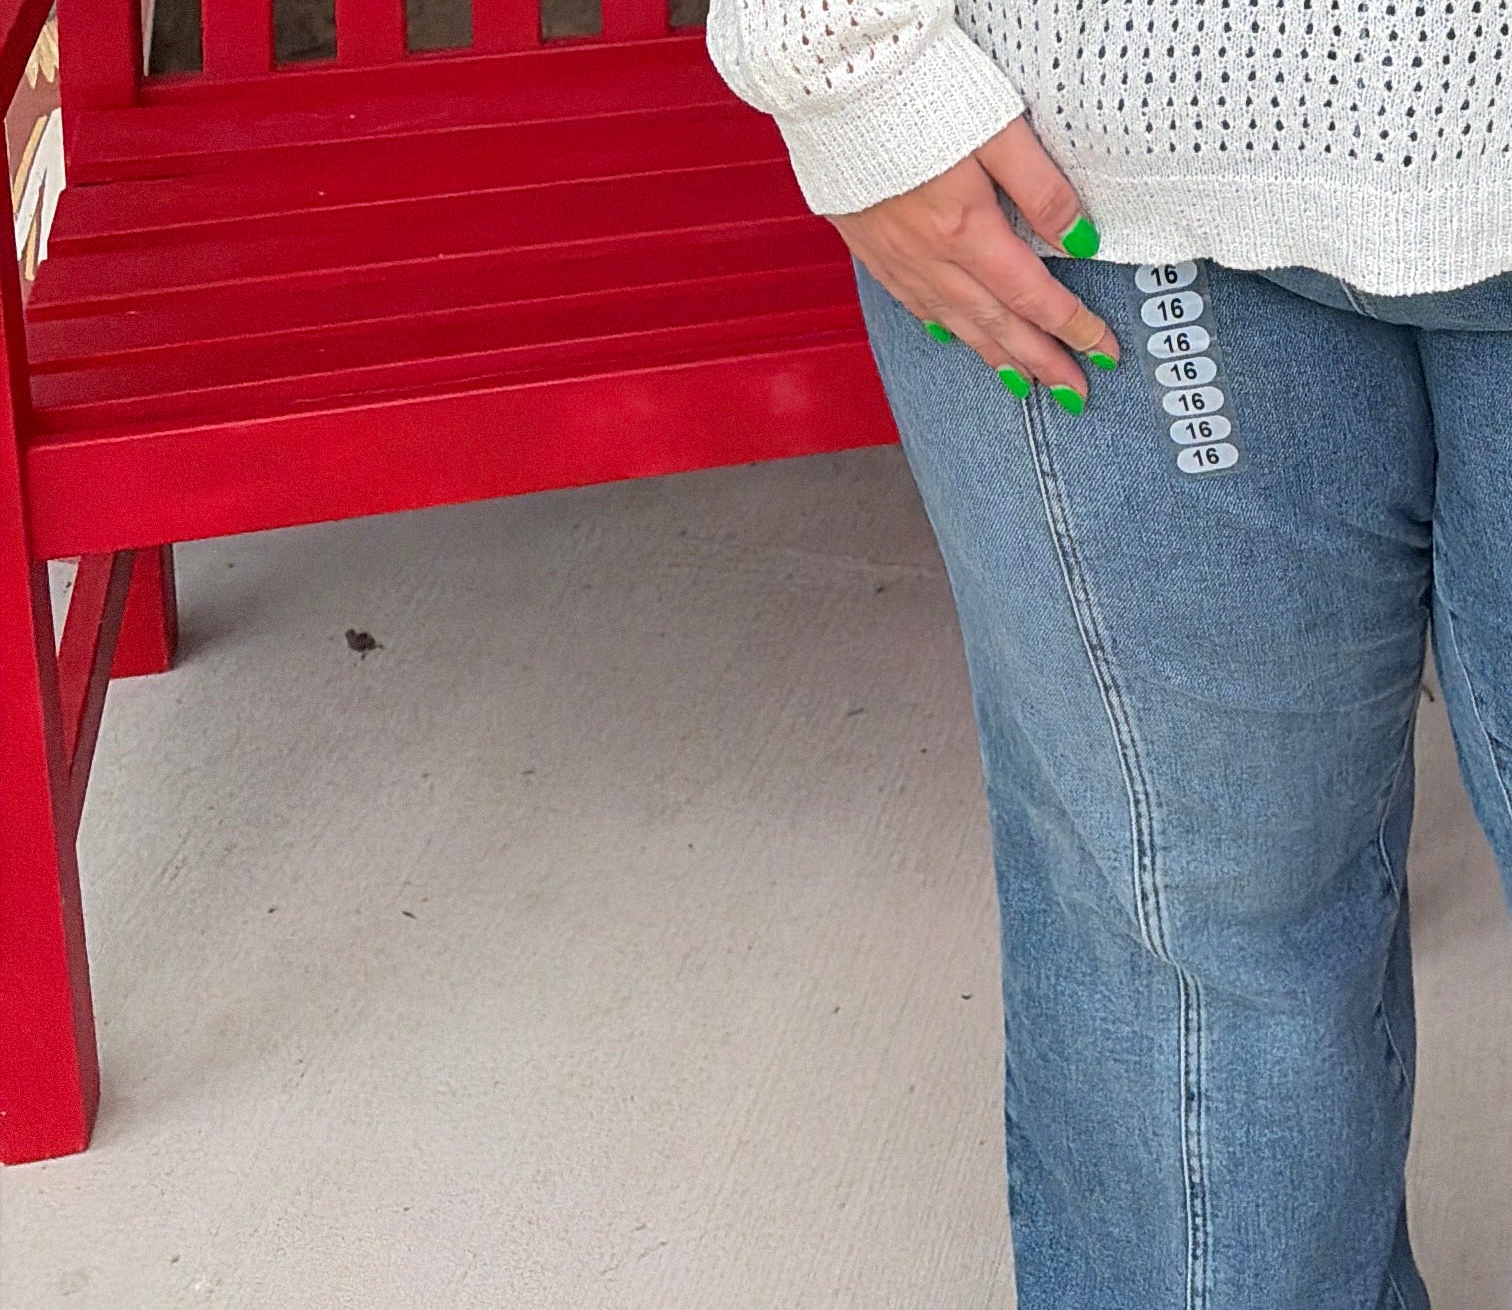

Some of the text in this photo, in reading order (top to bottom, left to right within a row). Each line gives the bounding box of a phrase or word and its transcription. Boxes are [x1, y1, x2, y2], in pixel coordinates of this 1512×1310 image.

[1150, 263, 1178, 287] 16
[1157, 297, 1184, 321] 16
[1163, 332, 1191, 353] 16
[1170, 361, 1198, 381] 16
[1178, 392, 1205, 412] 16
[1185, 420, 1213, 440] 16
[1192, 447, 1220, 467] 16
